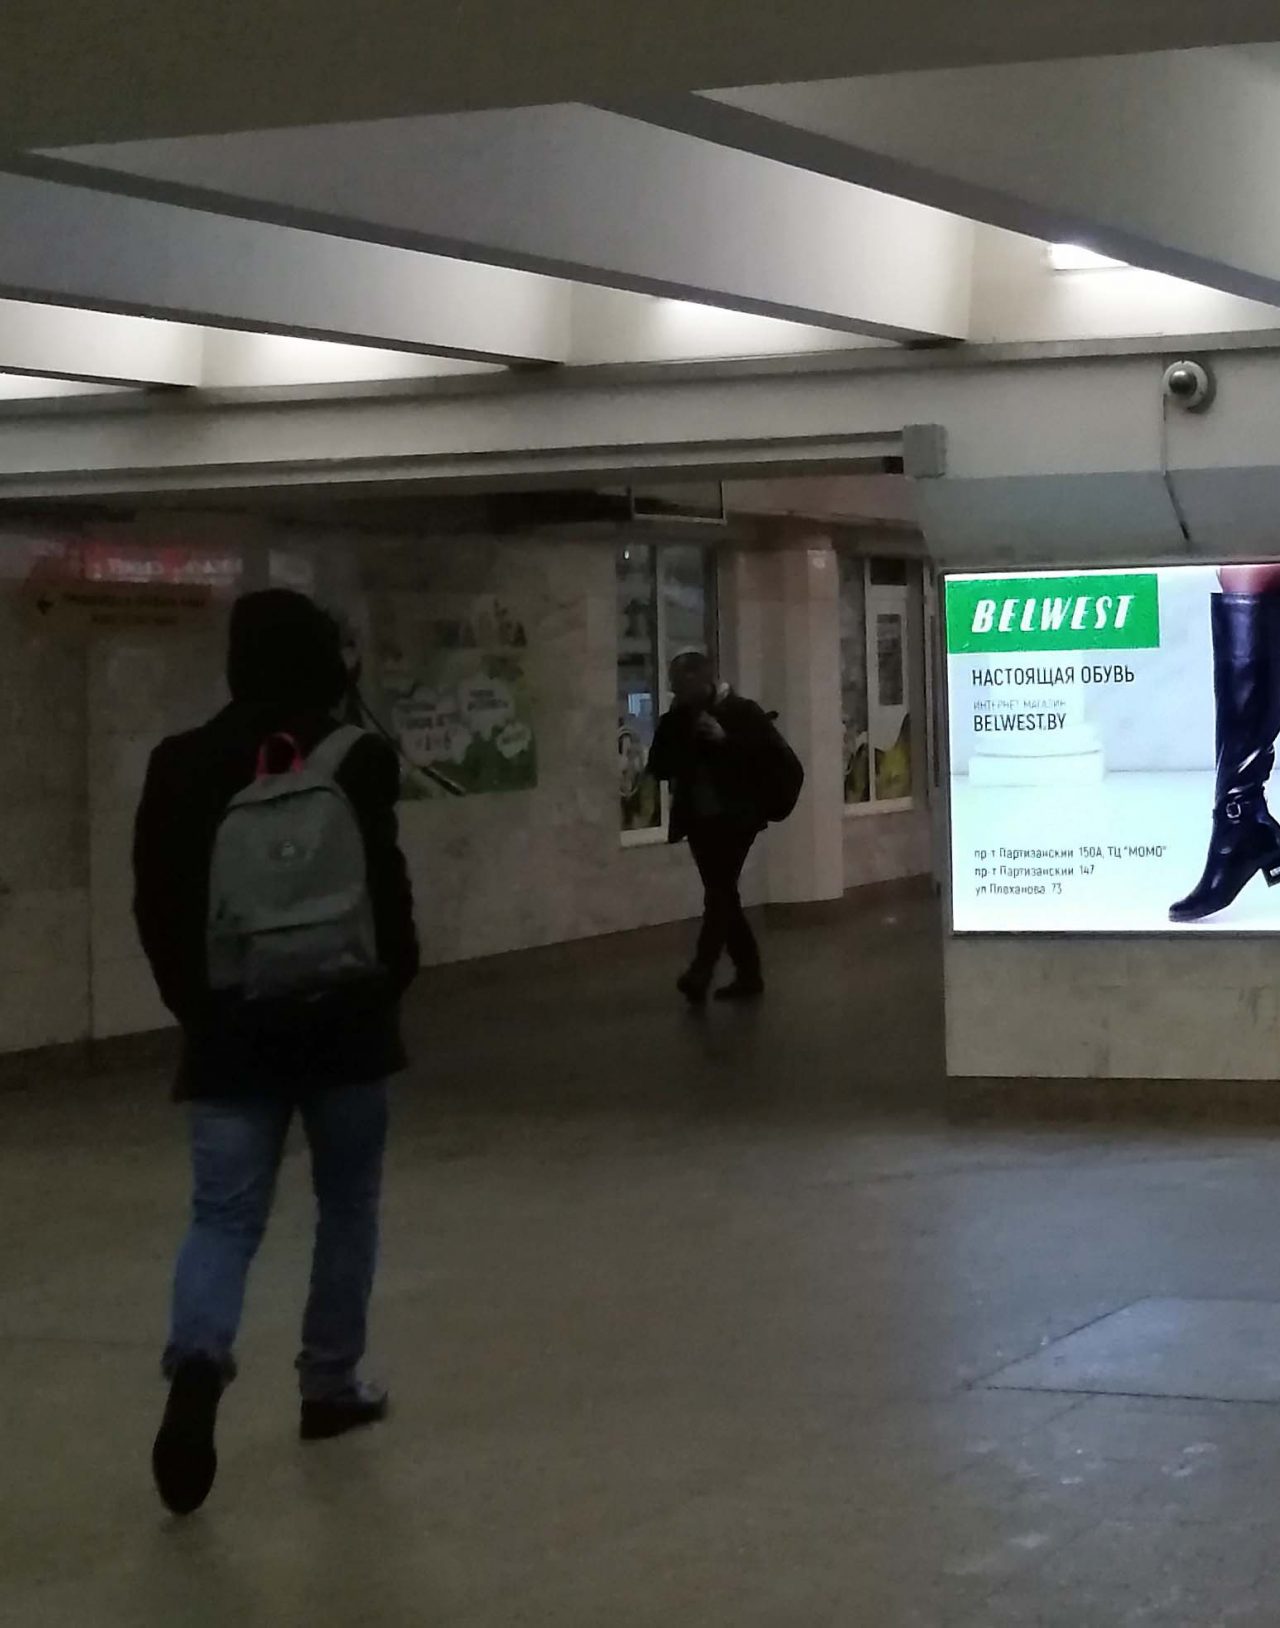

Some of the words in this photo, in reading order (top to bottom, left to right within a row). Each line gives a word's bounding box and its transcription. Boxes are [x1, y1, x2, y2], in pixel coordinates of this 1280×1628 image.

[970, 595, 1136, 634] BELWEST
[972, 667, 1075, 687] НАСТОЯЩАЯ
[1081, 664, 1135, 685] ОБУВЬ
[973, 713, 1067, 732] BELWEST.BY
[1107, 846, 1122, 859] ТЦ
[1079, 864, 1095, 876] 147
[1051, 882, 1063, 895] 73
